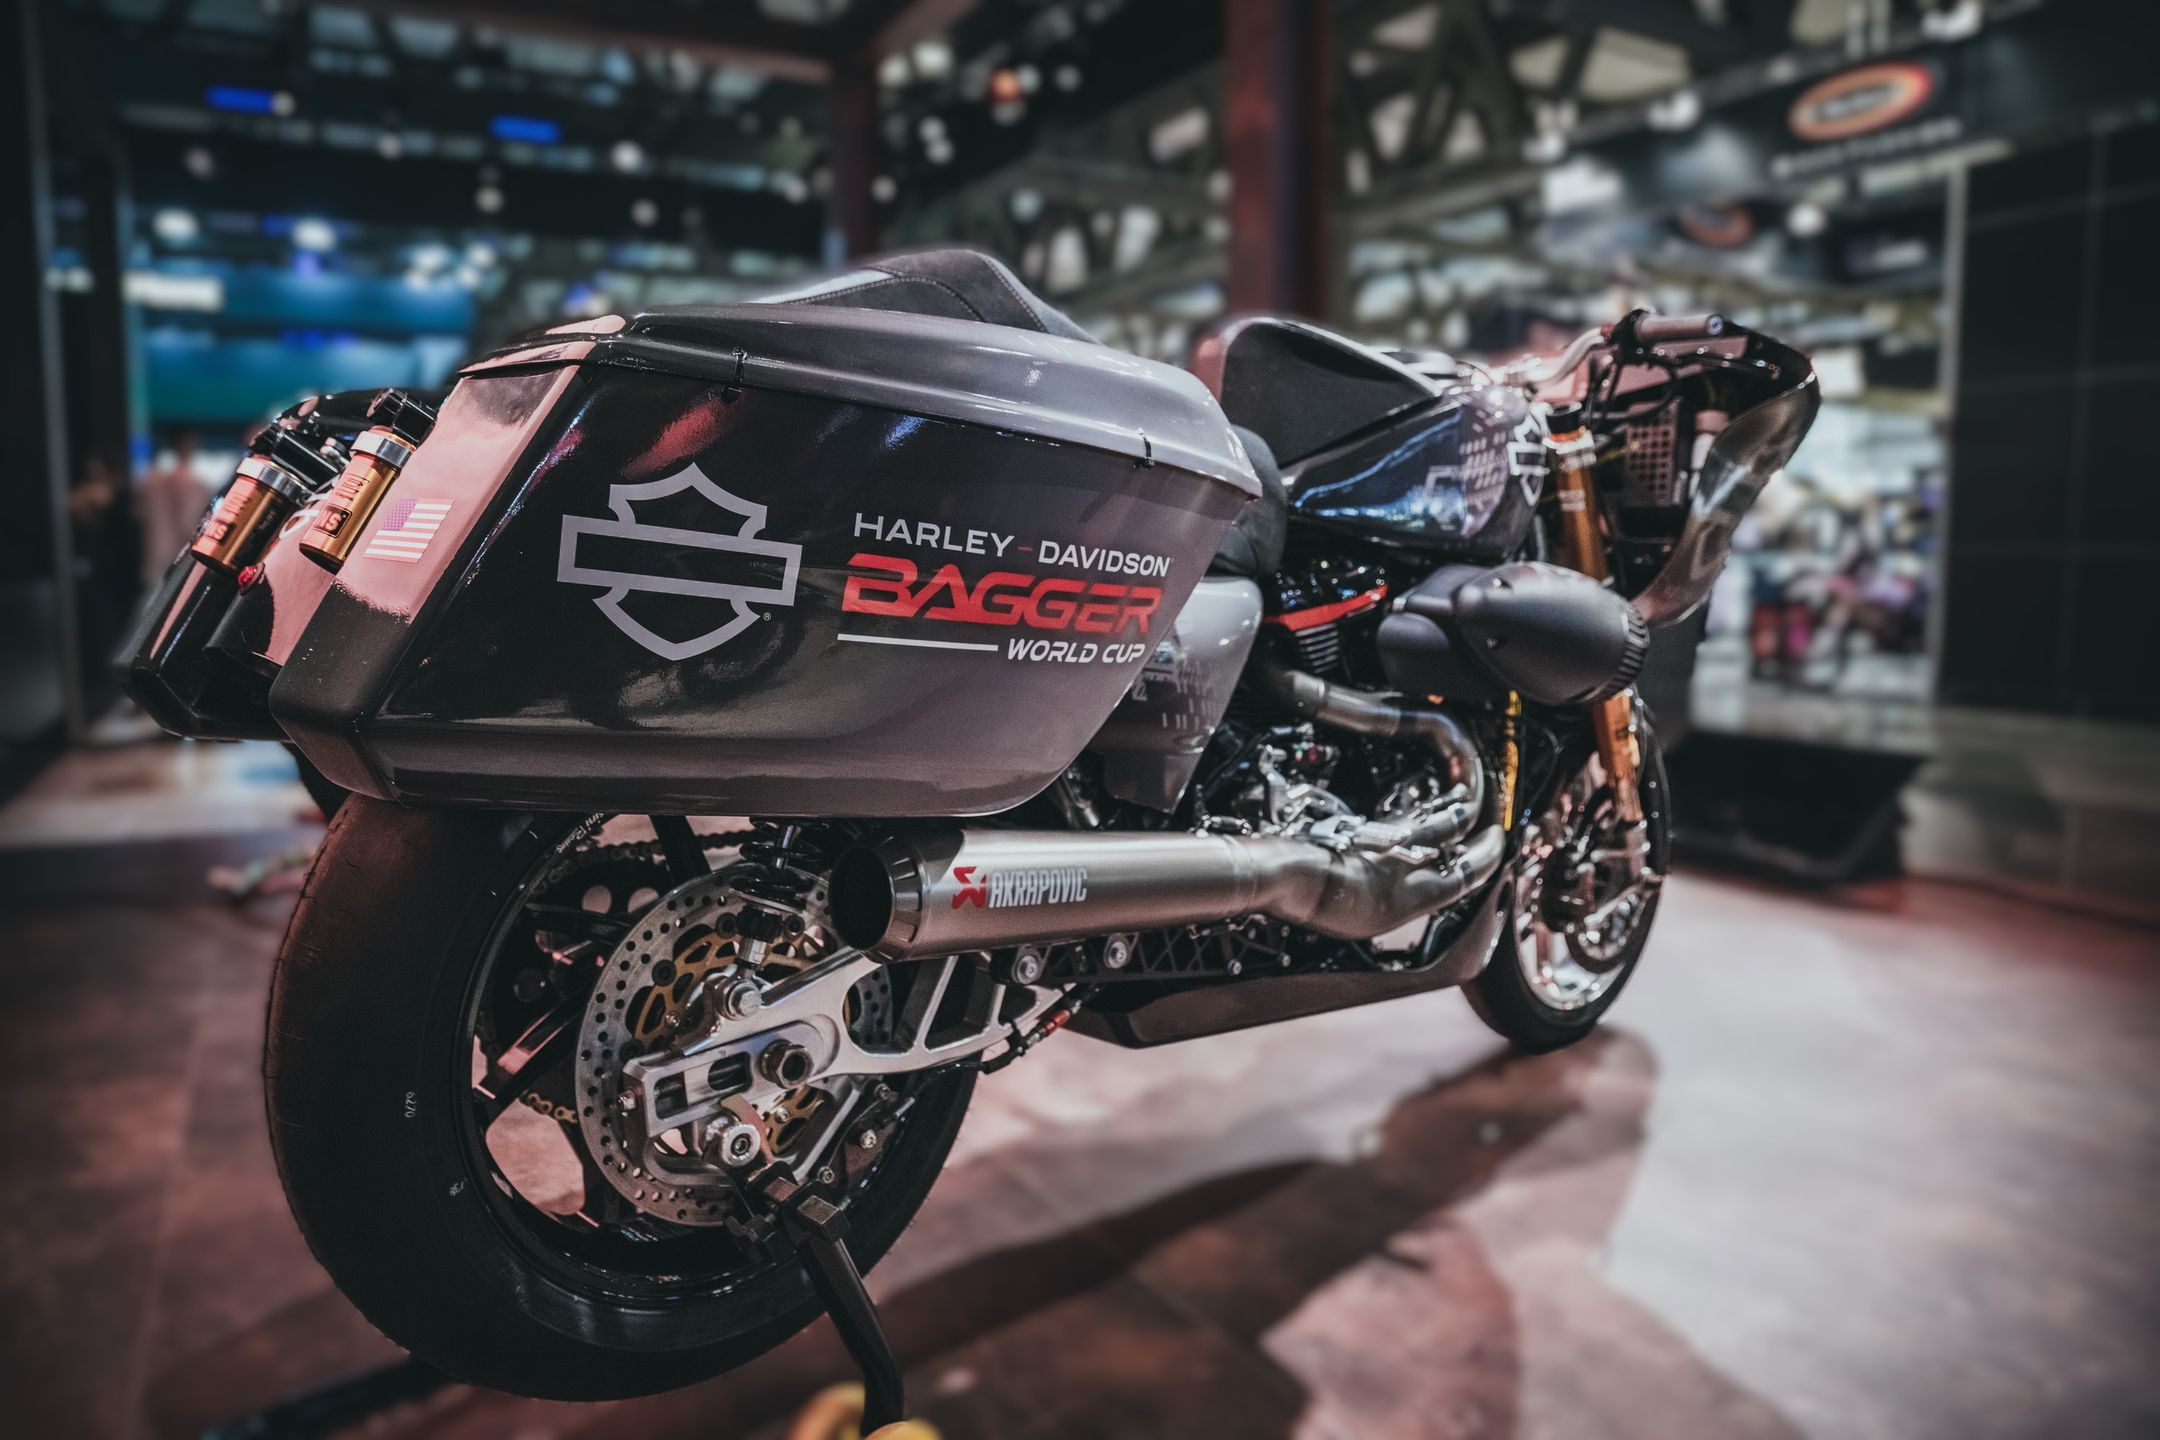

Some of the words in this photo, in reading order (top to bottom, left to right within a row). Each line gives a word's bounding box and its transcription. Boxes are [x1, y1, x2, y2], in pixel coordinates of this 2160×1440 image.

[842, 552, 1164, 633] BAGGER
[1007, 638, 1099, 663] WORLD
[1101, 642, 1147, 664] CUP
[988, 867, 1088, 908] AKRAPOVIC
